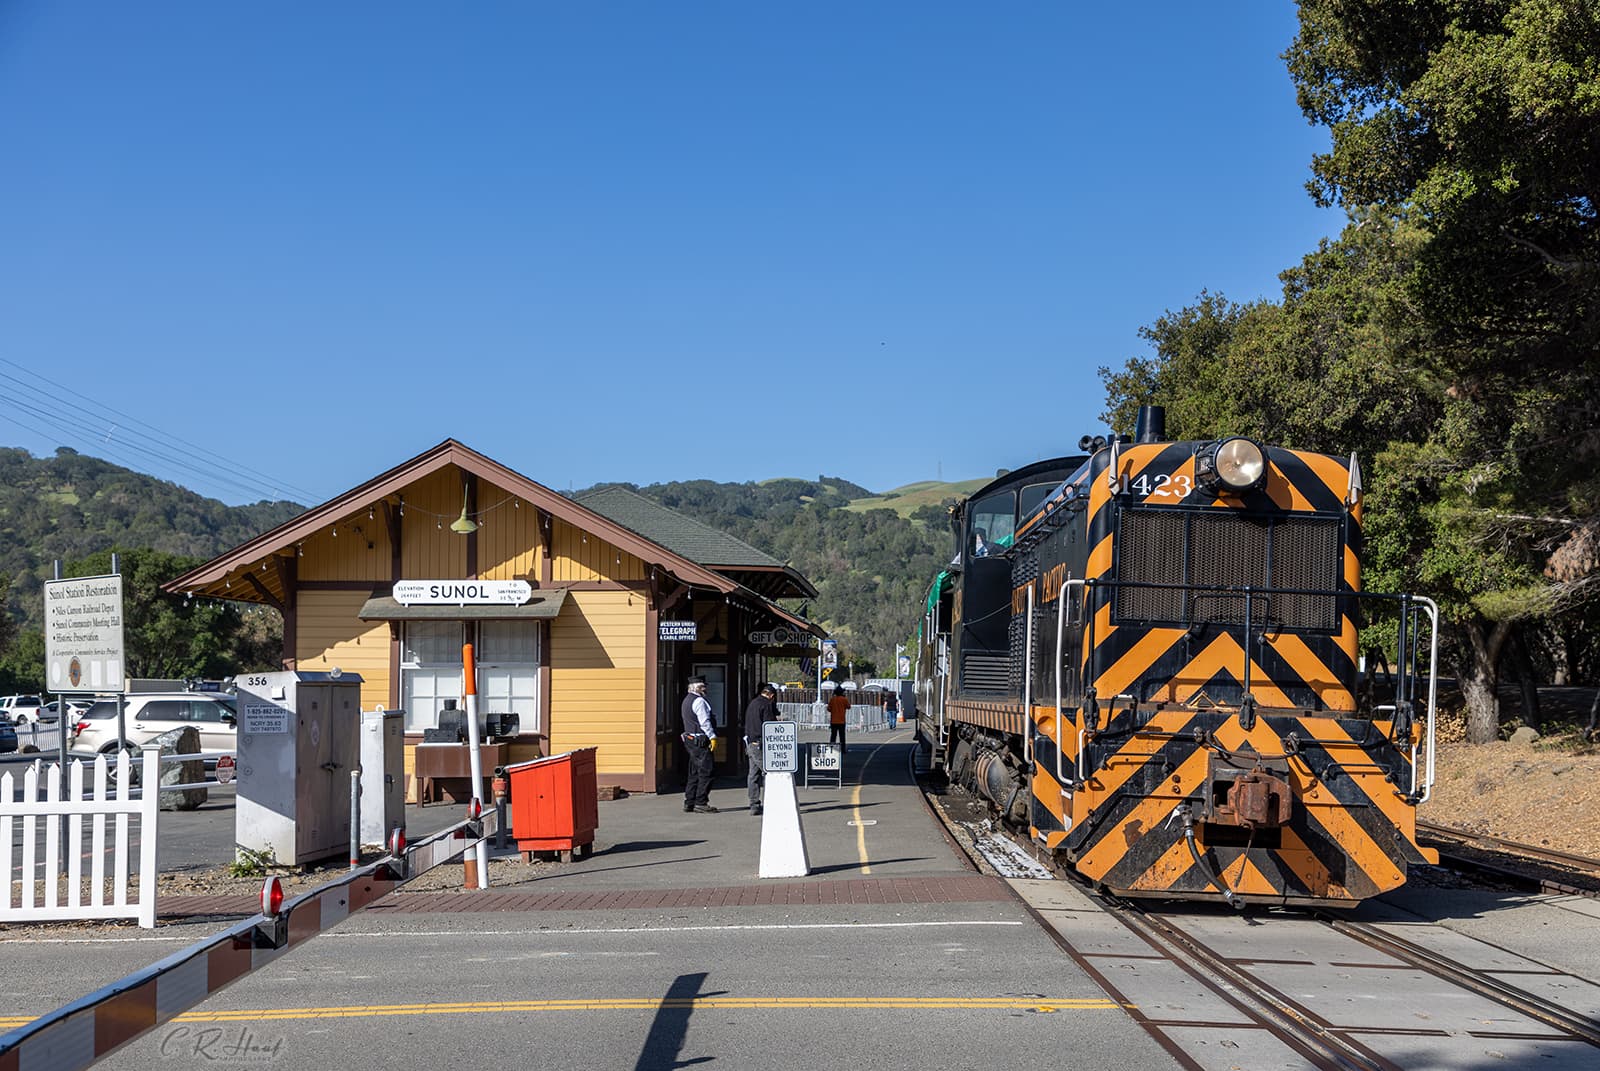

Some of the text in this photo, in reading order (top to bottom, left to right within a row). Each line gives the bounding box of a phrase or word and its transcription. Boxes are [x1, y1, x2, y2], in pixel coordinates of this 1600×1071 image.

[1119, 473, 1192, 498] 1423
[49, 583, 118, 600] Sunol Station Restoration
[430, 585, 490, 599] SUNOL
[55, 603, 115, 616] Niles Canyon Railroad Depot
[55, 619, 68, 629] Sunol
[68, 618, 92, 629] Community
[93, 617, 110, 628] Meeting
[659, 627, 697, 635] TELEGRAPH
[56, 631, 99, 643] Historic Preservation
[751, 632, 813, 643] GIFT SHOP
[248, 677, 267, 686] 356
[767, 743, 792, 751] BEYOND
[816, 745, 834, 754] GIFT
[815, 758, 837, 767] SHOP
